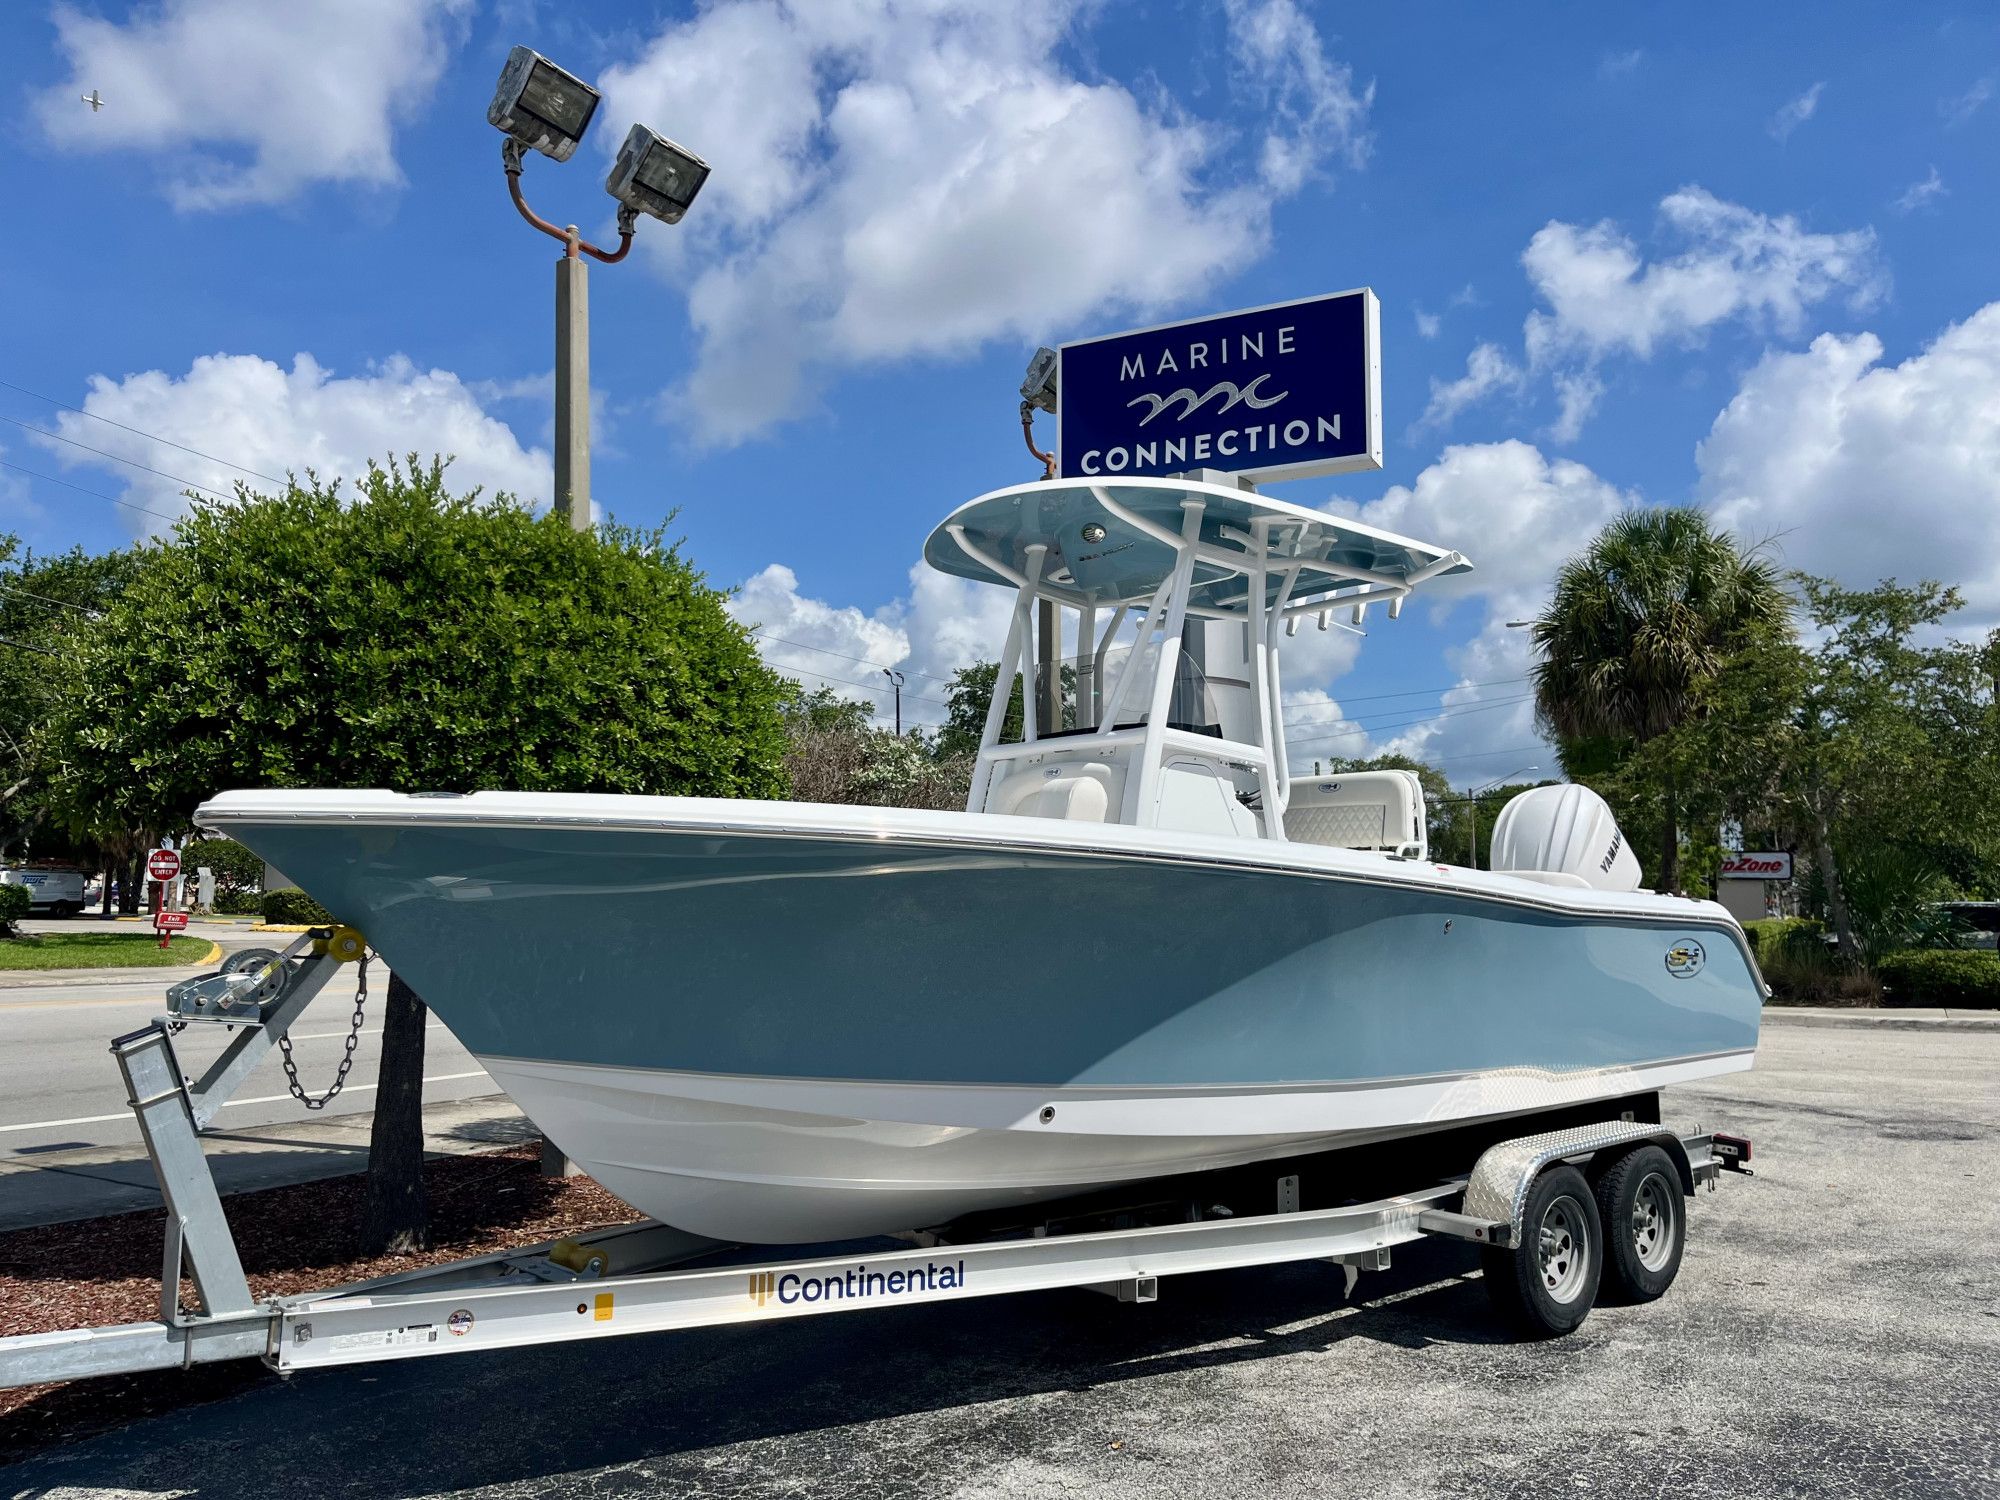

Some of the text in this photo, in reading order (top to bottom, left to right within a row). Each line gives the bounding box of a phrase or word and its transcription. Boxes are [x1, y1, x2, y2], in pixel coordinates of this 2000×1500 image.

[1120, 326, 1296, 382] MARINE
[1080, 414, 1341, 475] CONNECTION
[1721, 857, 1784, 873] oZone
[778, 1260, 965, 1304] Continental
